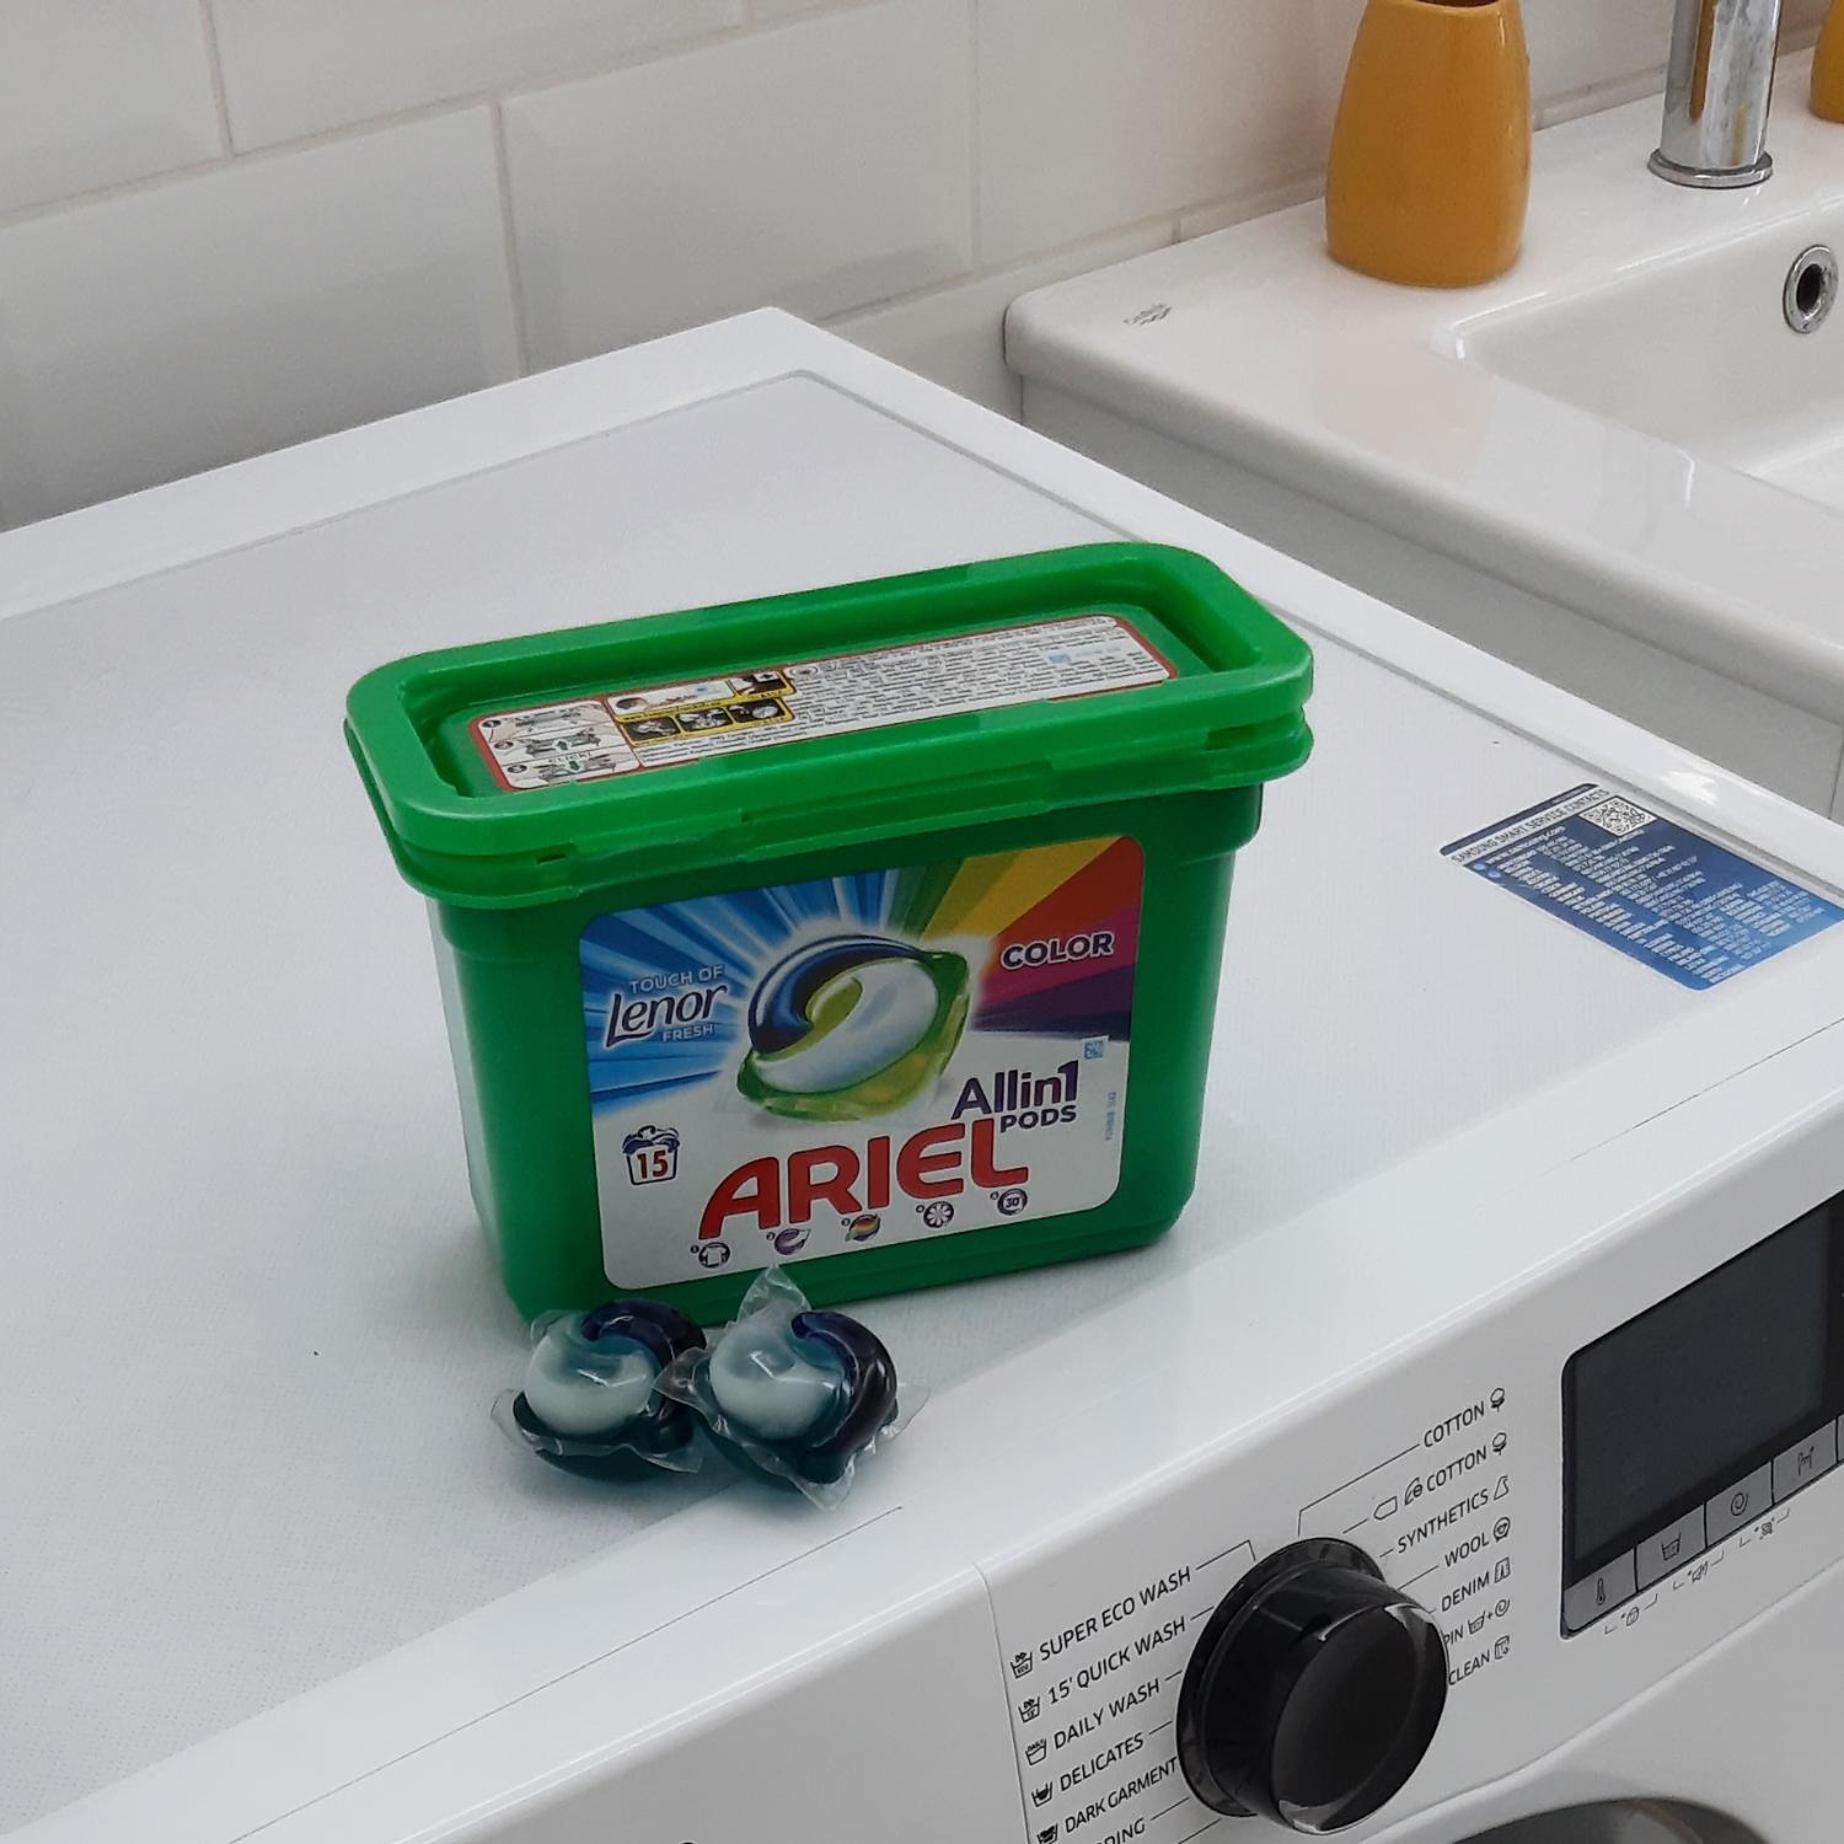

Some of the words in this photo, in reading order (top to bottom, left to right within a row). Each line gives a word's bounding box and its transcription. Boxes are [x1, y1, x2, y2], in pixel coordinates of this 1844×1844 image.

[1499, 825, 1528, 847] SMART
[1526, 808, 1568, 830] SERVICE
[1001, 932, 1114, 970] COLOR
[631, 970, 693, 994] TOUCH
[698, 964, 725, 981] OF
[604, 984, 729, 1048] Lenor
[662, 1023, 715, 1042] FRESH
[1000, 1105, 1078, 1134] PODS
[636, 1150, 670, 1180] 15
[698, 1117, 1030, 1240] ARIEL
[1424, 1401, 1485, 1447] COTTON
[1427, 1445, 1487, 1491] COTTON
[1398, 1488, 1490, 1554] SYNTHETICS
[1444, 1532, 1490, 1568] WOOL
[1039, 1617, 1099, 1661] SUPER
[1102, 1597, 1136, 1628] ECO
[1138, 1565, 1192, 1606] WASH
[1441, 1572, 1490, 1612] DENIM
[1077, 1647, 1130, 1689] QUICK
[1134, 1615, 1187, 1656] WASH
[1449, 1649, 1490, 1686] CLEAN
[1054, 1708, 1104, 1750] DAILY
[1108, 1678, 1160, 1719] WASH
[1060, 1732, 1144, 1792] DELICATES
[1065, 1799, 1107, 1834] DARK
[1108, 1756, 1178, 1808] GARMENT
[1096, 1817, 1146, 1844] DING
